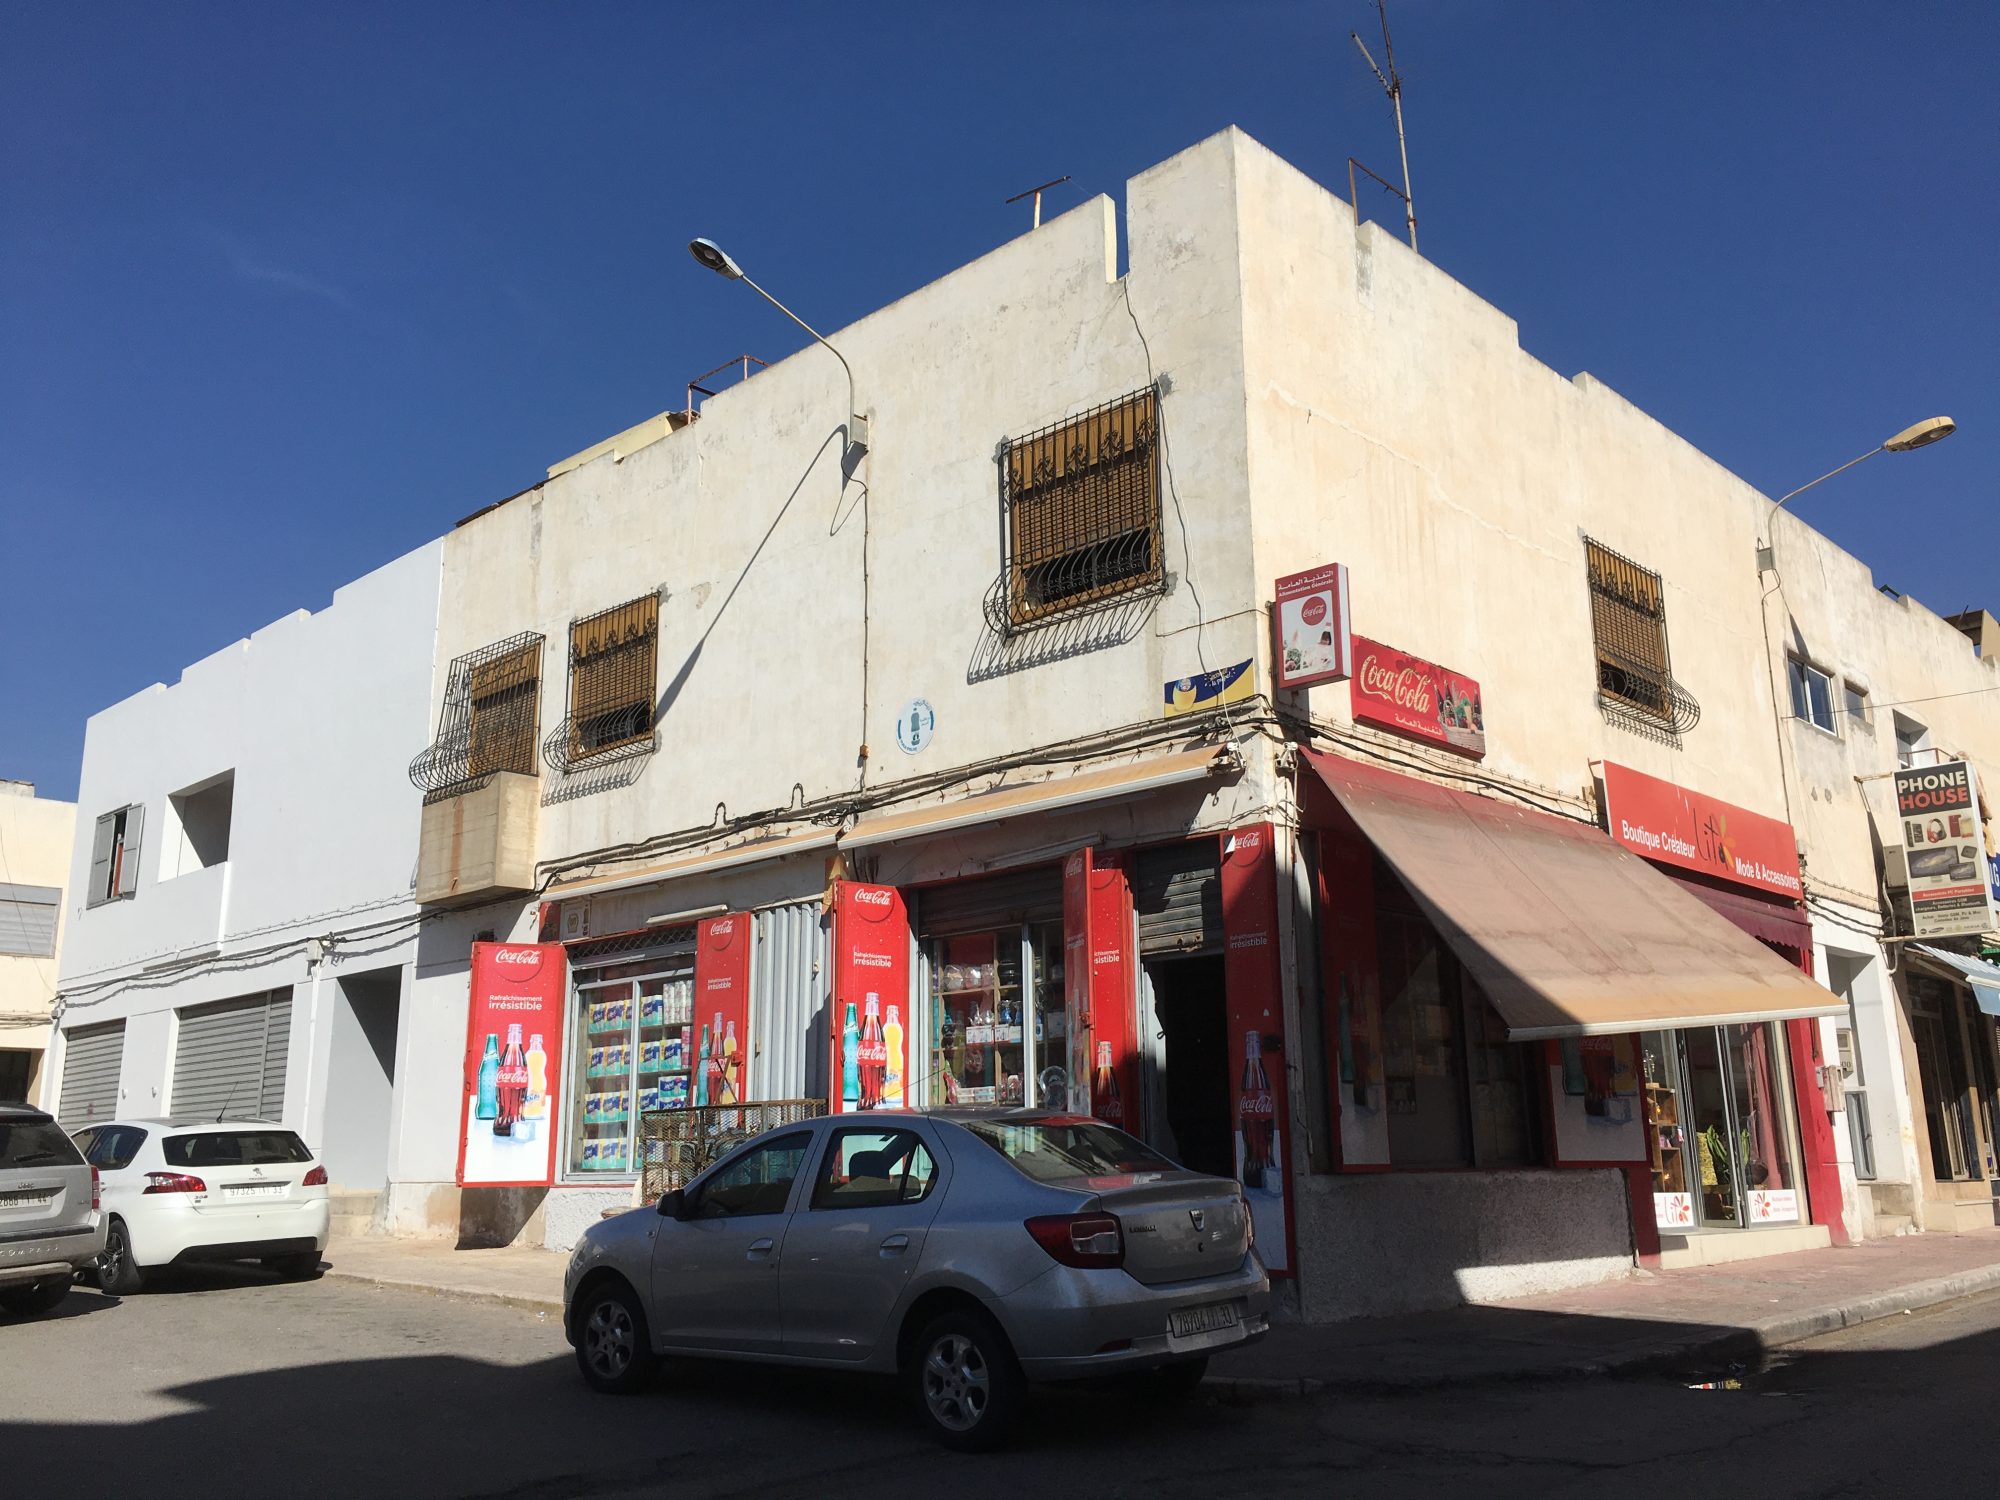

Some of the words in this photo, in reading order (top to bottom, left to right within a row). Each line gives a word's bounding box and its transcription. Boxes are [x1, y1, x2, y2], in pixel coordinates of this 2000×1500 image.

[1360, 654, 1432, 713] Coca-Cola
[1897, 771, 1967, 794] PHONE
[1899, 786, 1969, 811] HOUSE
[1621, 819, 1661, 852] Boutique
[1661, 834, 1696, 859] Créateur
[1735, 856, 1755, 878] Mode
[1755, 862, 1762, 880] &
[1762, 864, 1800, 892] Accessoires
[855, 888, 892, 906] Coca-Cola
[495, 949, 543, 965] Coca-Cola
[488, 1000, 543, 1010] irrésistible
